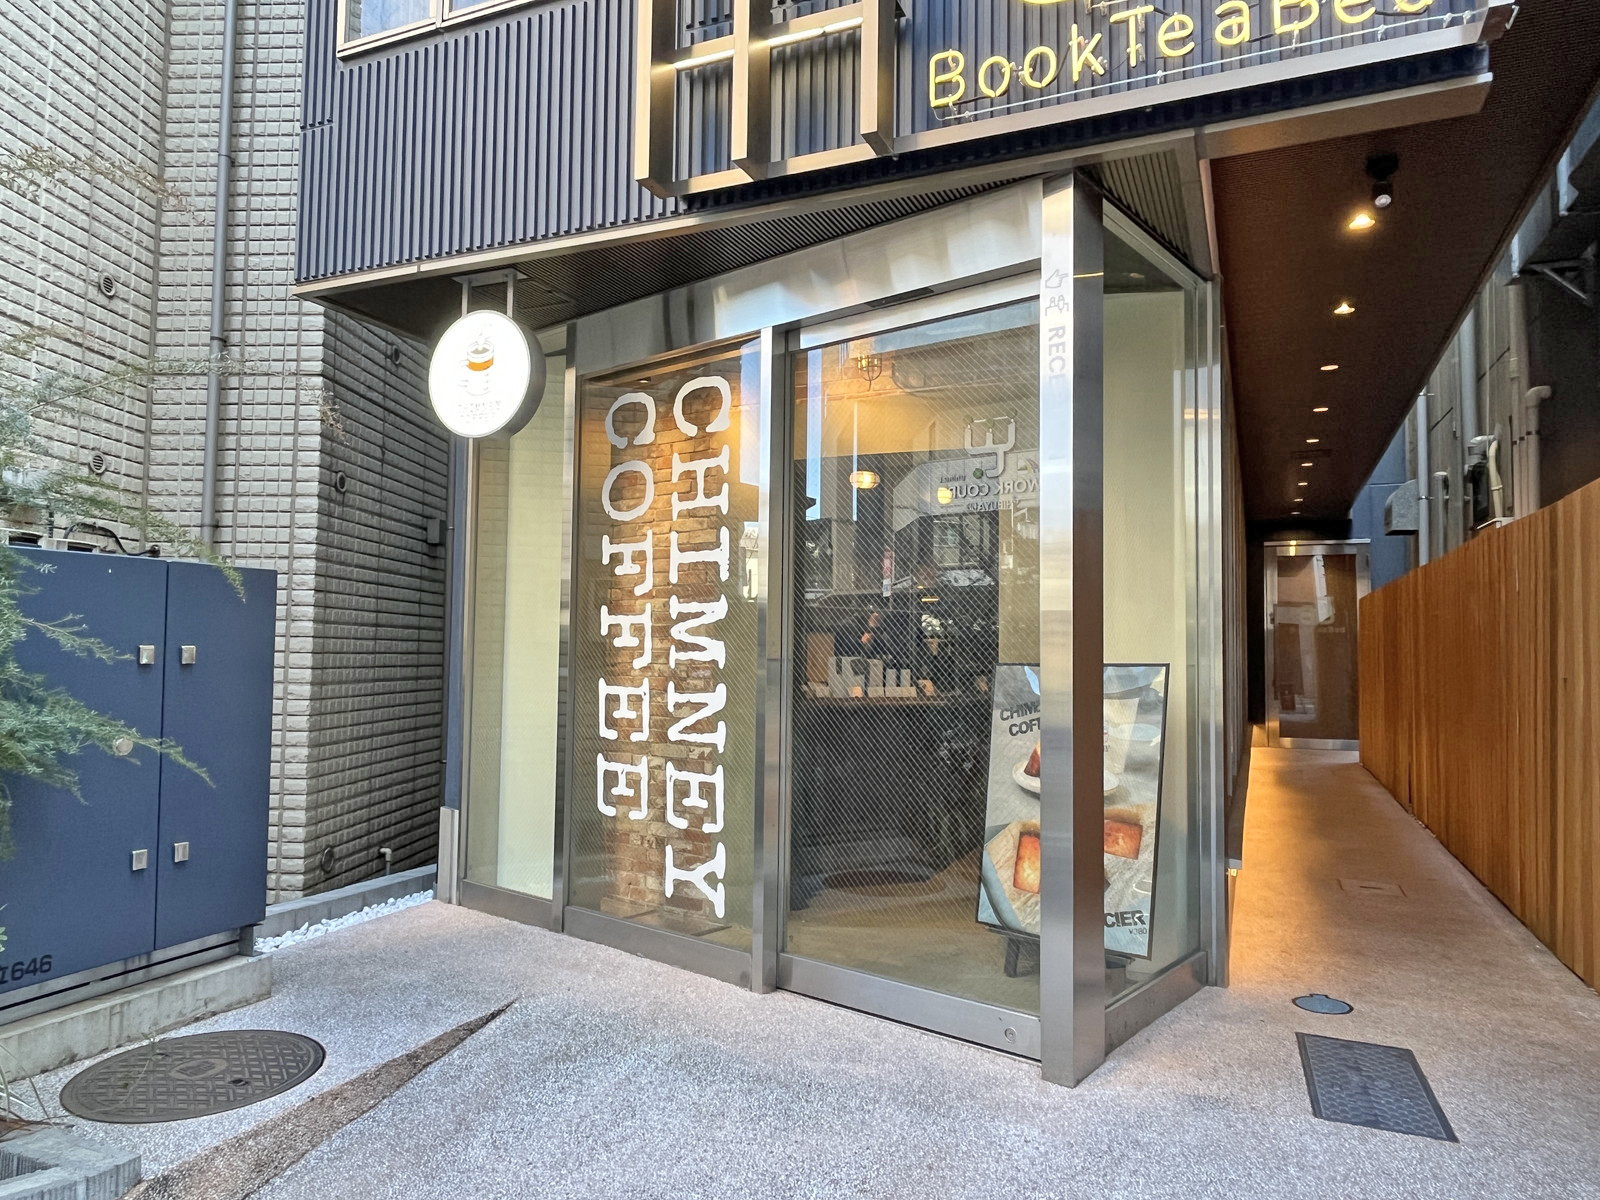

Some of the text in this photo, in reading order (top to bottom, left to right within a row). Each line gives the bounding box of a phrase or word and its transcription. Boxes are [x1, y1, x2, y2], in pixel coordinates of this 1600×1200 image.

[928, 0, 1433, 108] BookTeaBe
[596, 391, 657, 821] COFFEE
[664, 375, 732, 919] CHIMNEY
